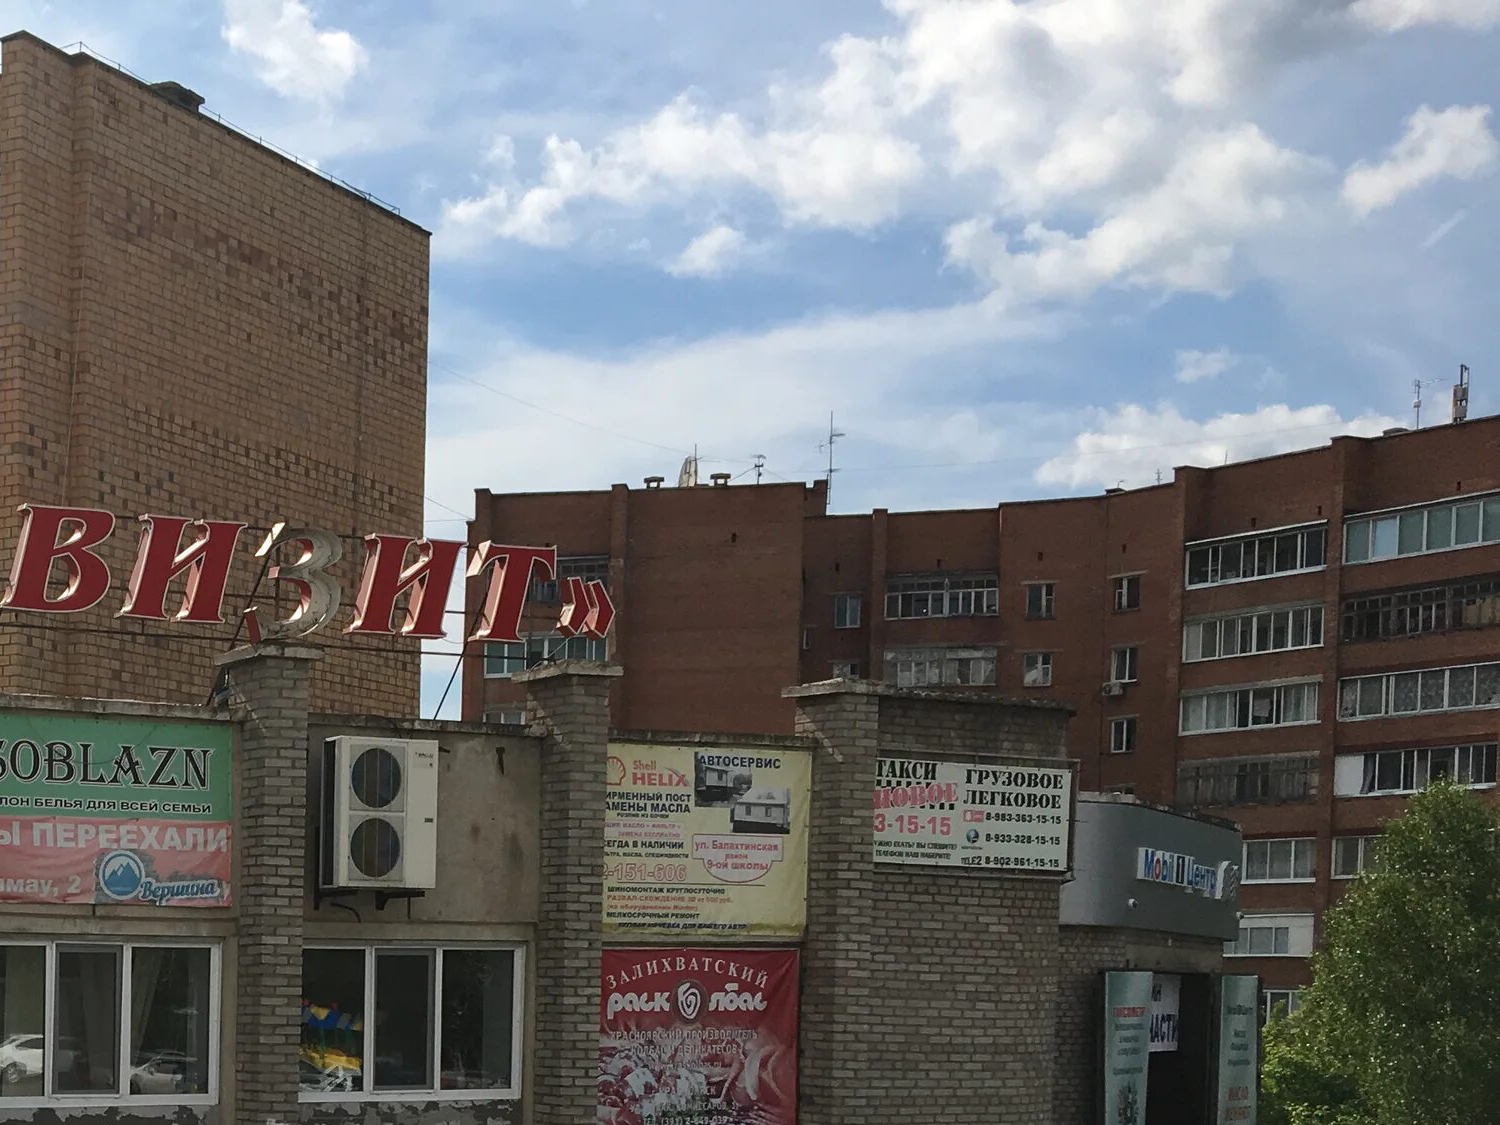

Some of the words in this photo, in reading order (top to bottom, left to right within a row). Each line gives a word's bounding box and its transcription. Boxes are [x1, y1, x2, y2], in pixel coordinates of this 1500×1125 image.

[633, 760, 657, 771] Shell
[699, 755, 781, 769] АВТОСЕРВИС
[876, 759, 937, 781] ТАКСИ
[632, 772, 689, 787] HELIX
[965, 768, 1064, 790] ГРУЗОВОЕ
[666, 793, 692, 803] ПОСТ
[963, 789, 1062, 809] ЛЕГКОВОЕ
[34, 797, 83, 809] БЕЛЬЯ
[86, 800, 116, 812] ДЛЯ
[120, 800, 158, 812] ВСЕЙ
[162, 803, 211, 814] СЕМЬИ
[651, 803, 691, 814] МАСЛА
[985, 812, 1062, 825] 8-983-363-15-15
[32, 822, 228, 852] ПЕРЕЕХАЛИ
[985, 833, 1061, 846] 8-933-328-15-15
[632, 840, 638, 848] В
[641, 840, 684, 850] НАЛИЧИИ
[694, 841, 710, 851] ул.
[712, 839, 778, 851] Балахтинская
[731, 861, 769, 871] школы
[1143, 849, 1174, 882] Mobil
[67, 875, 81, 893] 2
[139, 878, 220, 900] Вершина
[607, 886, 665, 894] ШИНОМОНТАЖ
[606, 956, 769, 990] ЗАЛИХВАТСКИЙ
